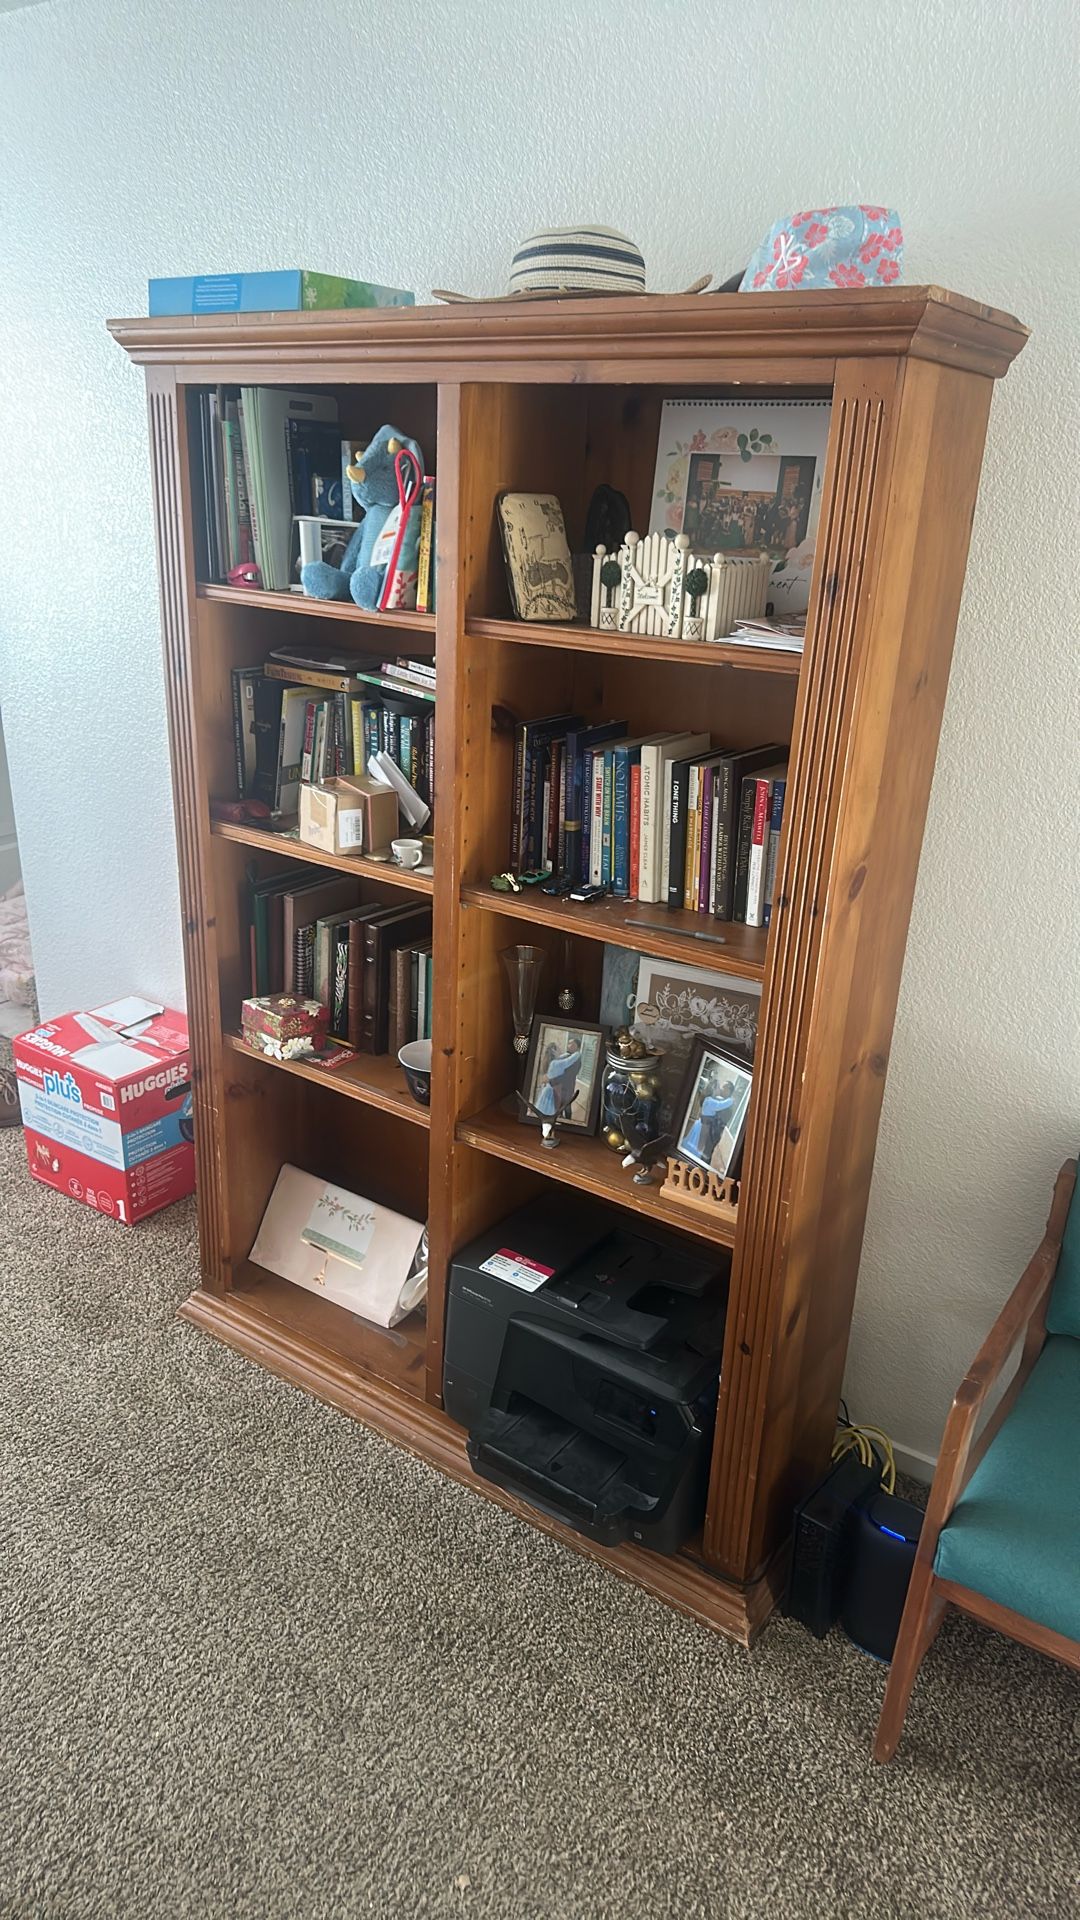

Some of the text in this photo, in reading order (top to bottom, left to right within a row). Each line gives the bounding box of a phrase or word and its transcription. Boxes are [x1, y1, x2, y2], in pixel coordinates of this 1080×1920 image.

[616, 760, 625, 822] NO LIMITS
[756, 813, 764, 841] MAXWELL
[20, 1032, 71, 1057] HUGGIES
[15, 1058, 43, 1078] HUGGIES
[44, 1073, 81, 1104] plus
[120, 1062, 188, 1104] HUGGIES
[666, 1157, 740, 1207] HOM
[116, 1200, 127, 1222] 1
